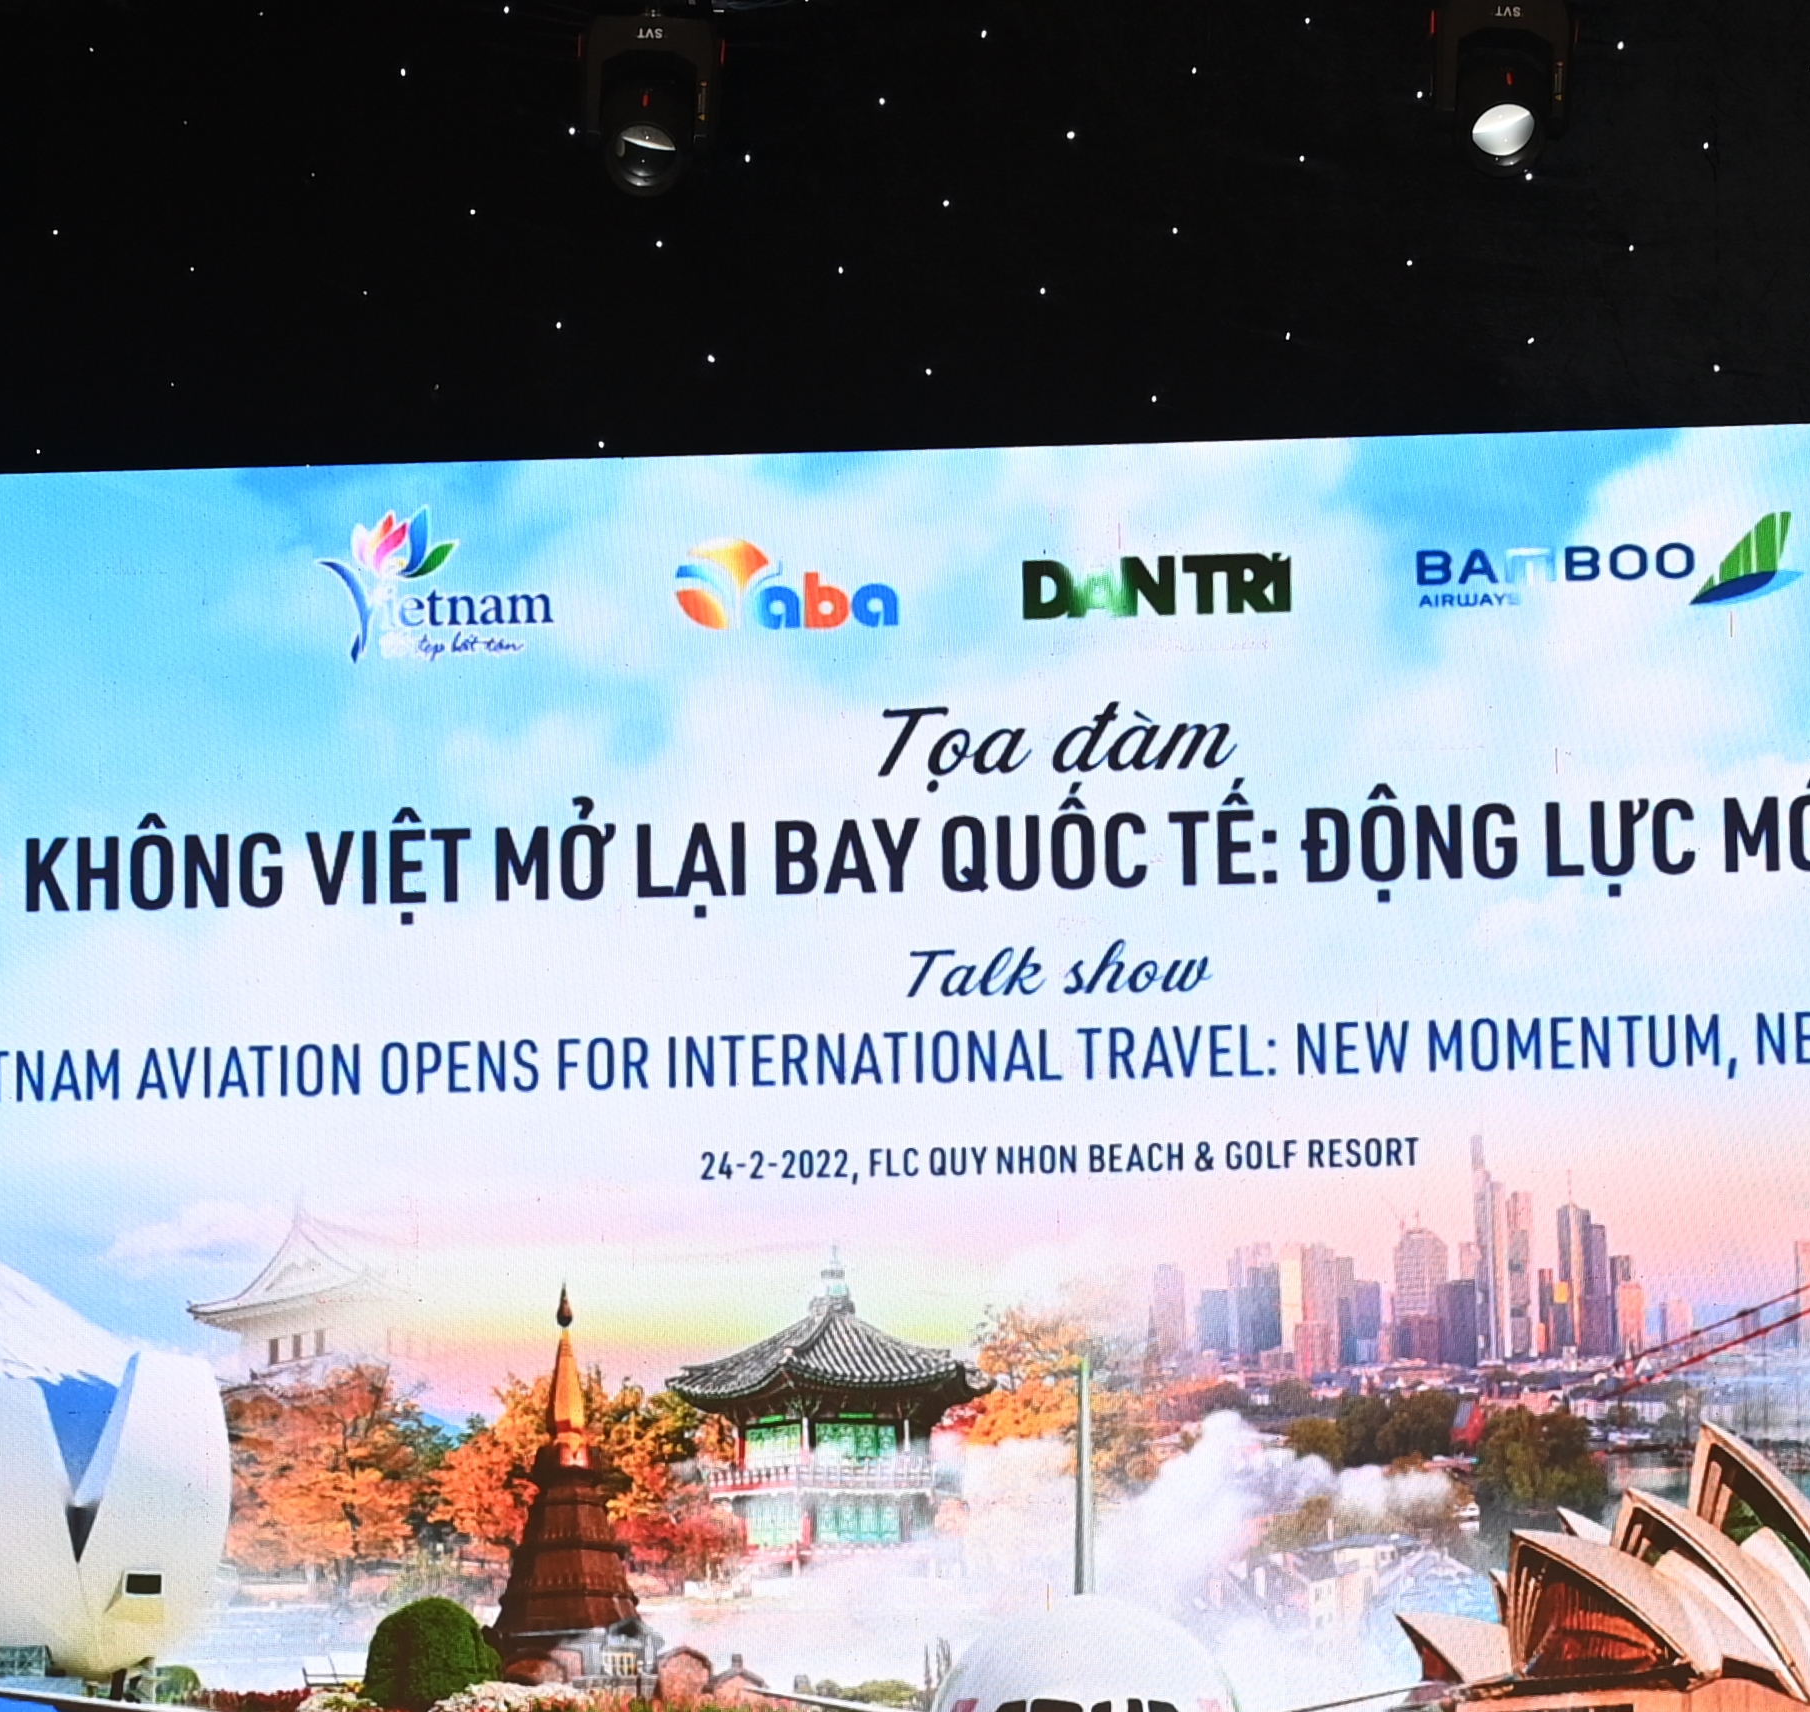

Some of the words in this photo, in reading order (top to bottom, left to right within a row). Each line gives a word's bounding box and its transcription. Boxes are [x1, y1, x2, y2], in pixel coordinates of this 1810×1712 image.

[636, 27, 663, 39] SVT
[878, 706, 1032, 793] Tọa
[1053, 701, 1241, 773] đàm
[25, 813, 283, 912] KHÔNG
[305, 807, 471, 926] VIỆT
[495, 796, 617, 902] MỞ
[636, 821, 746, 918] LẠI
[775, 818, 920, 895] BAY
[942, 780, 1148, 893] QUỐC
[1169, 778, 1278, 886] TẾ:
[1301, 783, 1518, 903] ĐỘNG
[1546, 799, 1696, 898] LỰC
[907, 946, 1042, 998] Talk
[1063, 938, 1211, 995] show
[136, 1043, 360, 1100] AVIATION
[381, 1038, 539, 1095] OPENS
[558, 1036, 649, 1091] FOR
[668, 1028, 1063, 1089] INTERNATIONAL
[1077, 1023, 1277, 1081] TRAVEL:
[1297, 1020, 1410, 1075] NEW
[1428, 1013, 1738, 1080] MOMENTUM,
[700, 1148, 859, 1184] 24-2-2022,
[869, 1148, 919, 1177] FLC
[929, 1146, 987, 1177] QUY
[996, 1145, 1077, 1175] NHON
[1089, 1142, 1184, 1173] BEACH
[1194, 1142, 1214, 1172] &
[1225, 1140, 1298, 1171] GOLF
[1308, 1137, 1419, 1169] RESORT
